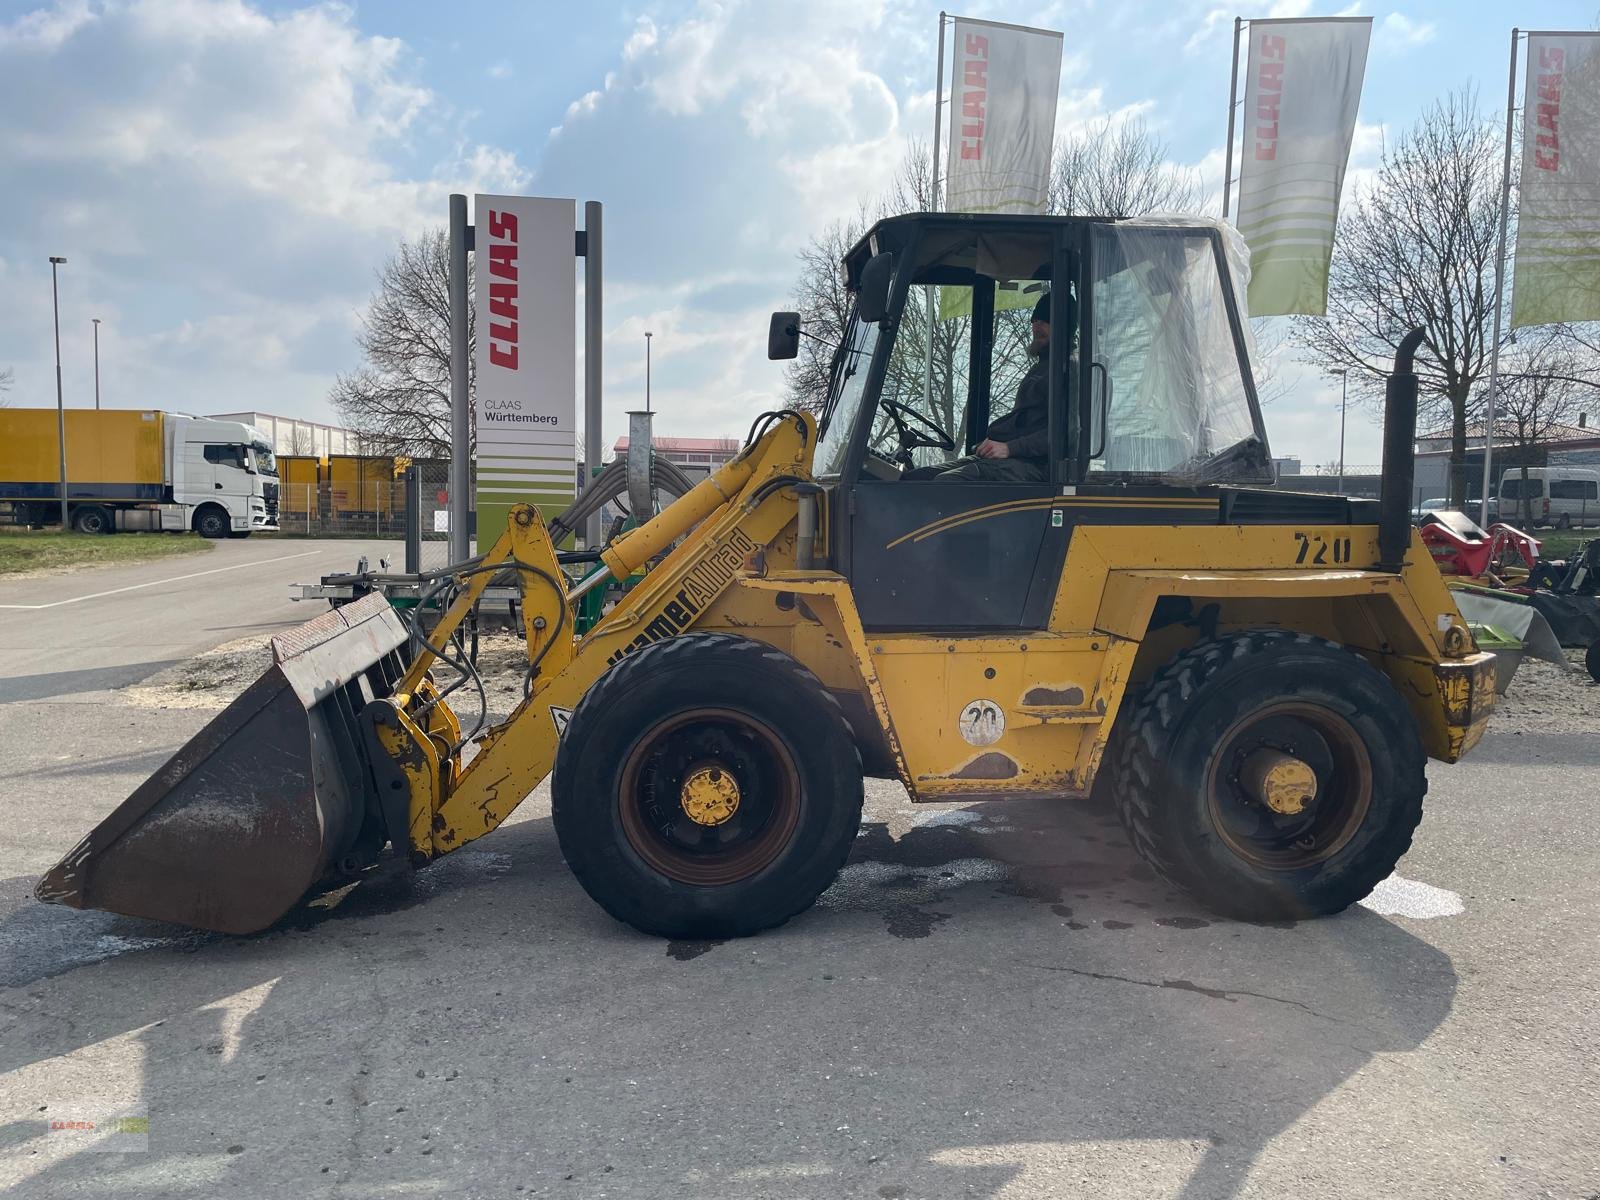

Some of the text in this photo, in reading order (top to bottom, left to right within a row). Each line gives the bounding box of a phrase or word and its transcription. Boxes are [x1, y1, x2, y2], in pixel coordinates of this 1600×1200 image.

[961, 33, 988, 160] CLAAS
[1255, 35, 1286, 160] CLAAS
[1535, 45, 1564, 171] CLAAS
[489, 209, 519, 370] CLAAS
[484, 399, 522, 411] CLAAS
[484, 411, 559, 426] Württemberg
[1294, 531, 1351, 565] 720
